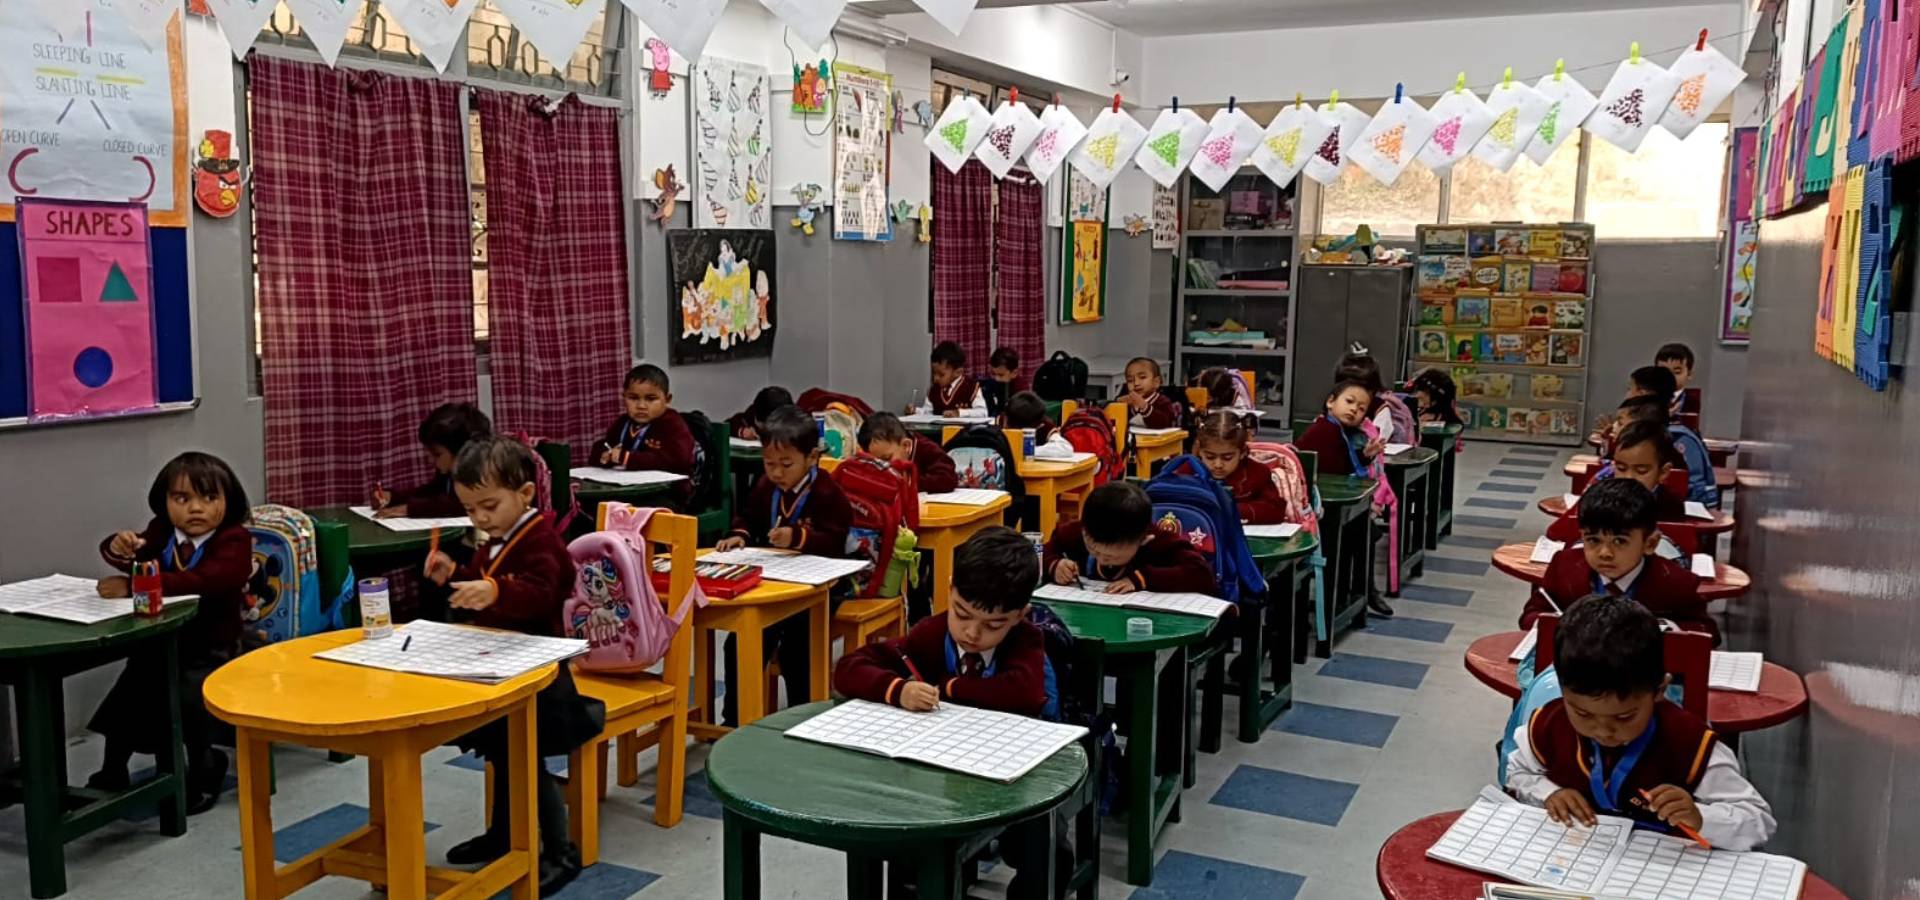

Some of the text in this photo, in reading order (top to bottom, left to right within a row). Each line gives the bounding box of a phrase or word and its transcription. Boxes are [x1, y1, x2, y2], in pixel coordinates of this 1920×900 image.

[33, 43, 127, 70] SLEEPING LINE
[35, 75, 131, 102] SLANTING LINE
[29, 132, 61, 147] CURVE
[103, 140, 168, 157] CLOSED CURVE
[45, 210, 134, 237] SHAPES
